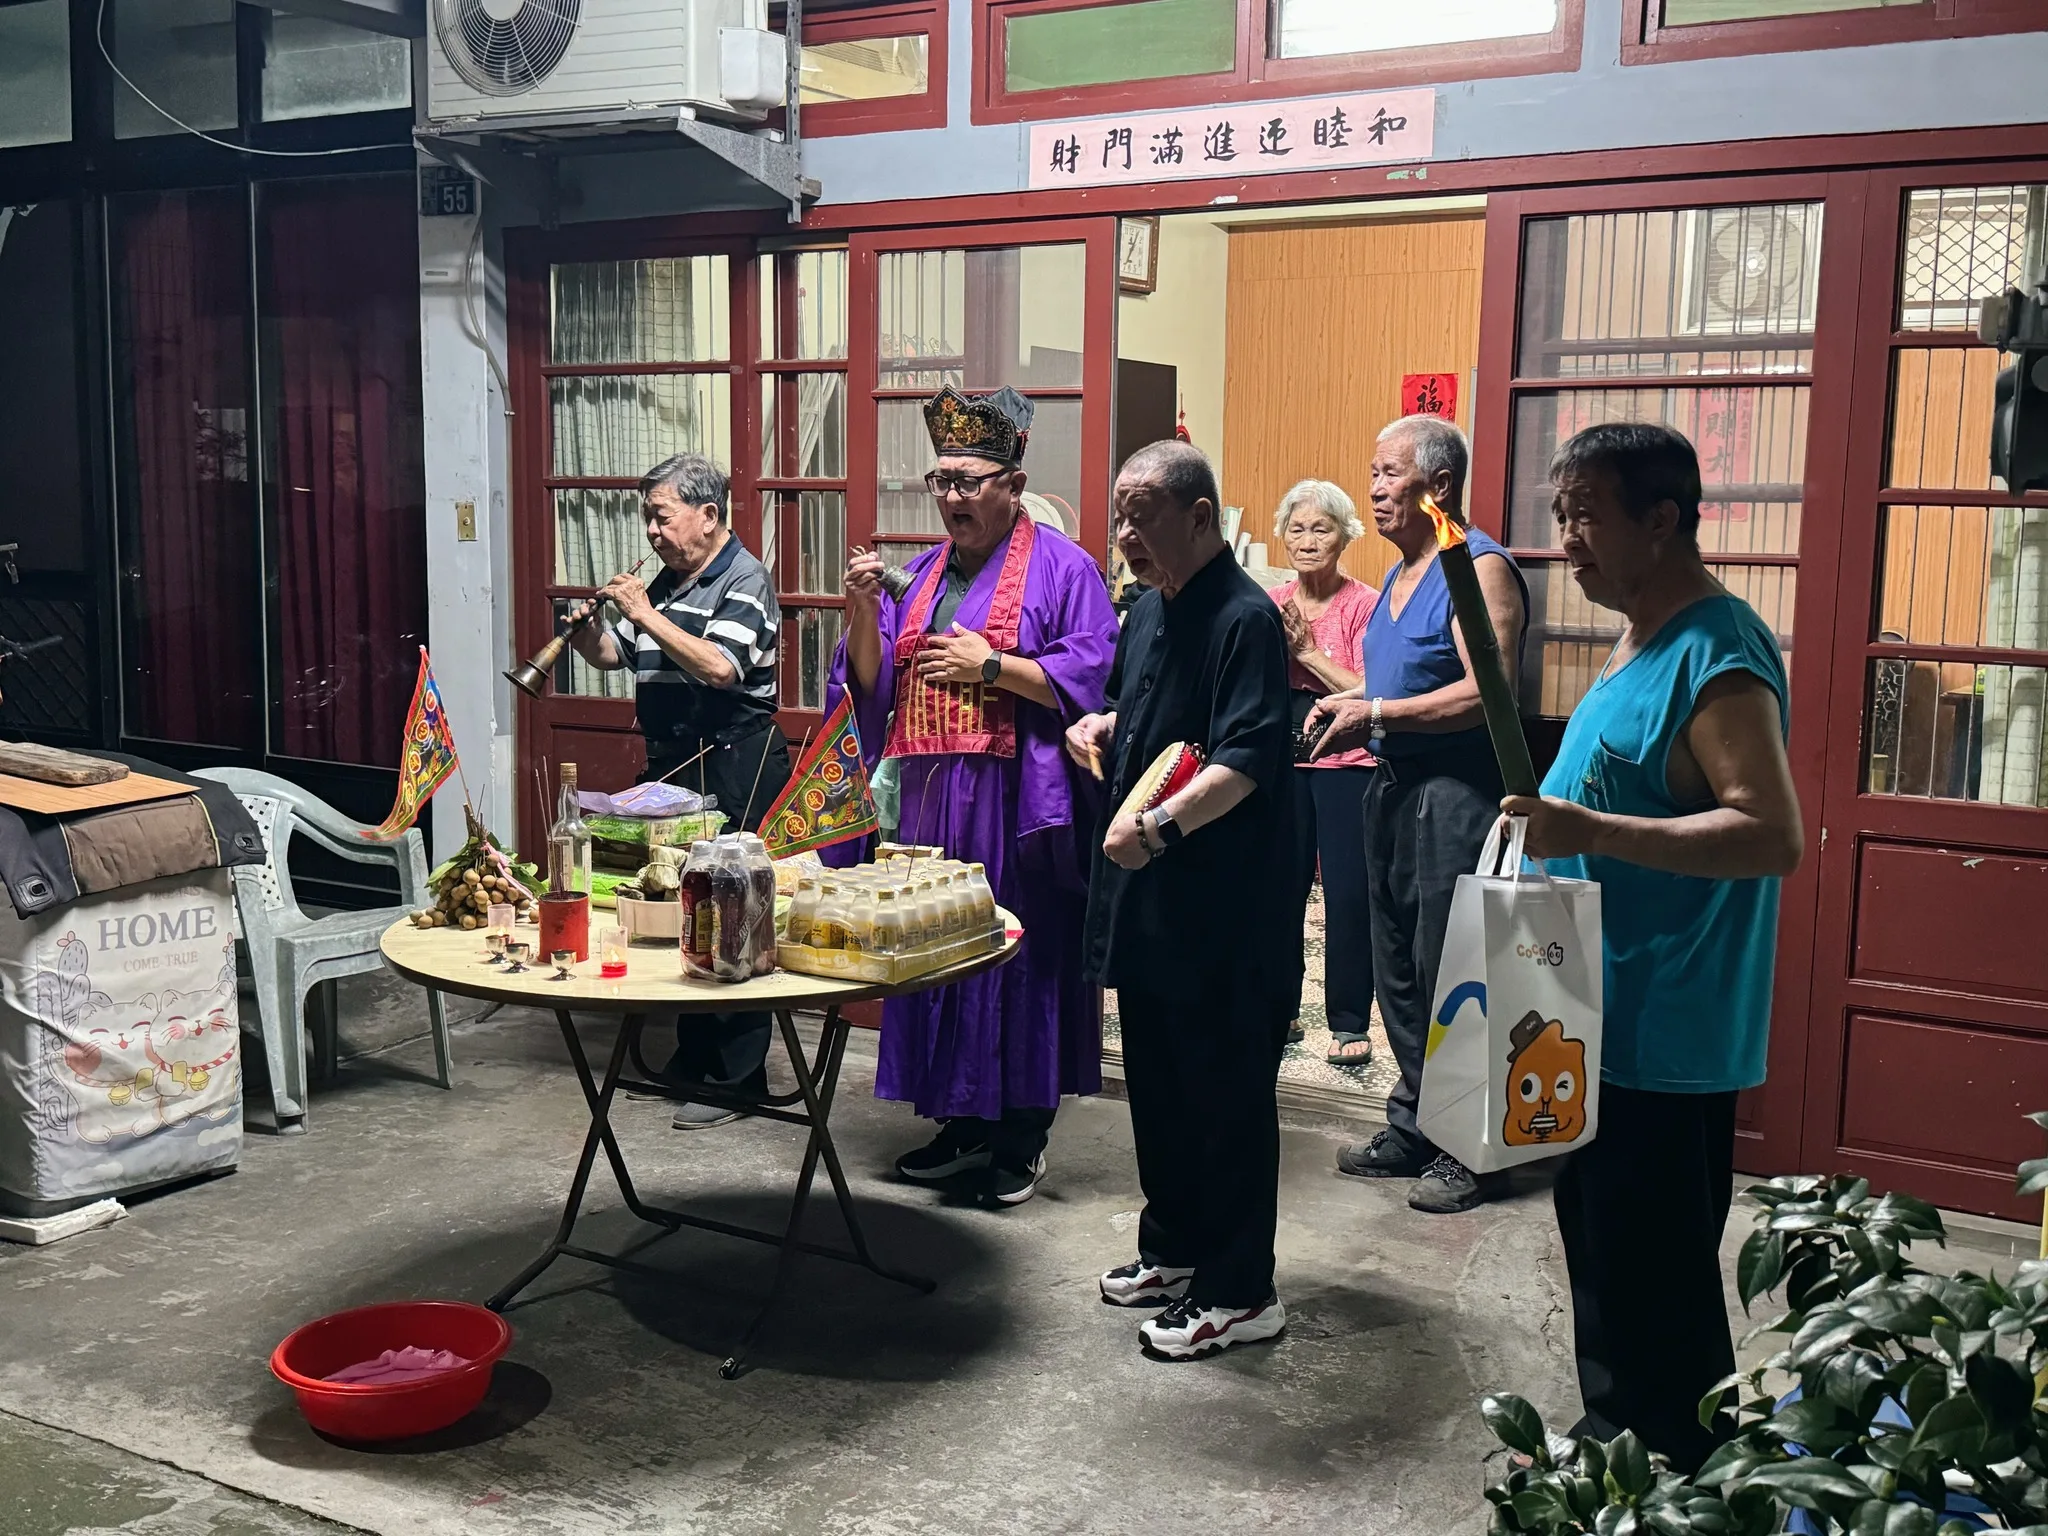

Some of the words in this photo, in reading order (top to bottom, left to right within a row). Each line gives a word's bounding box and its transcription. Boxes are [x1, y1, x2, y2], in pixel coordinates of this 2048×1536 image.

[443, 185, 468, 213] 55
[1416, 377, 1443, 414] 福
[98, 905, 217, 951] HOME
[123, 956, 160, 973] COME
[165, 950, 199, 967] TRUE
